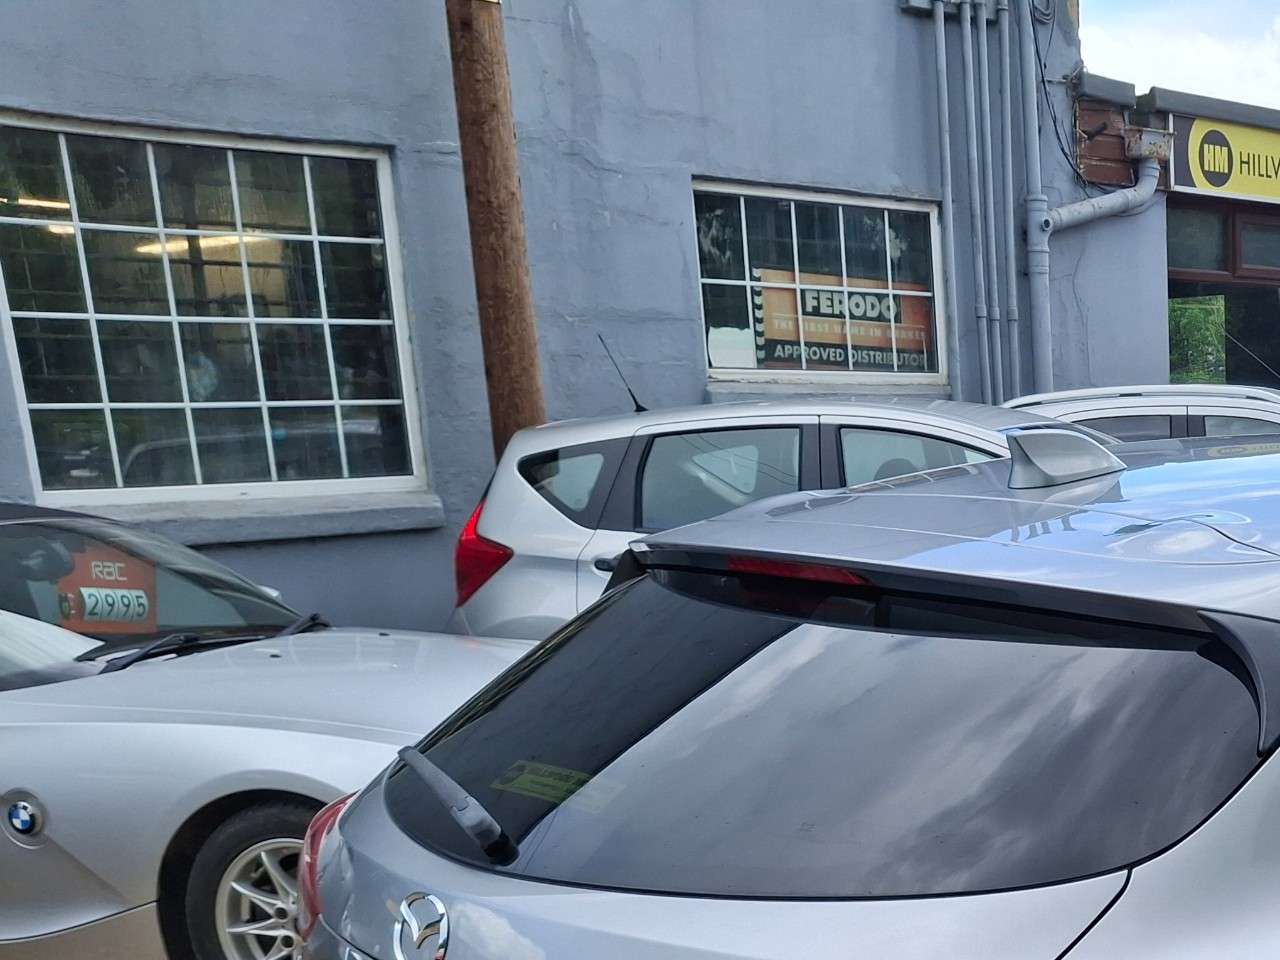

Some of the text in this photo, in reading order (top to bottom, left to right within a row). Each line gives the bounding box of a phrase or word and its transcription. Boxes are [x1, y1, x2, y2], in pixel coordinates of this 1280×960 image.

[1203, 143, 1229, 173] HM
[805, 289, 898, 319] FERODO
[774, 343, 845, 361] APPROVED
[87, 592, 147, 617] 2995
